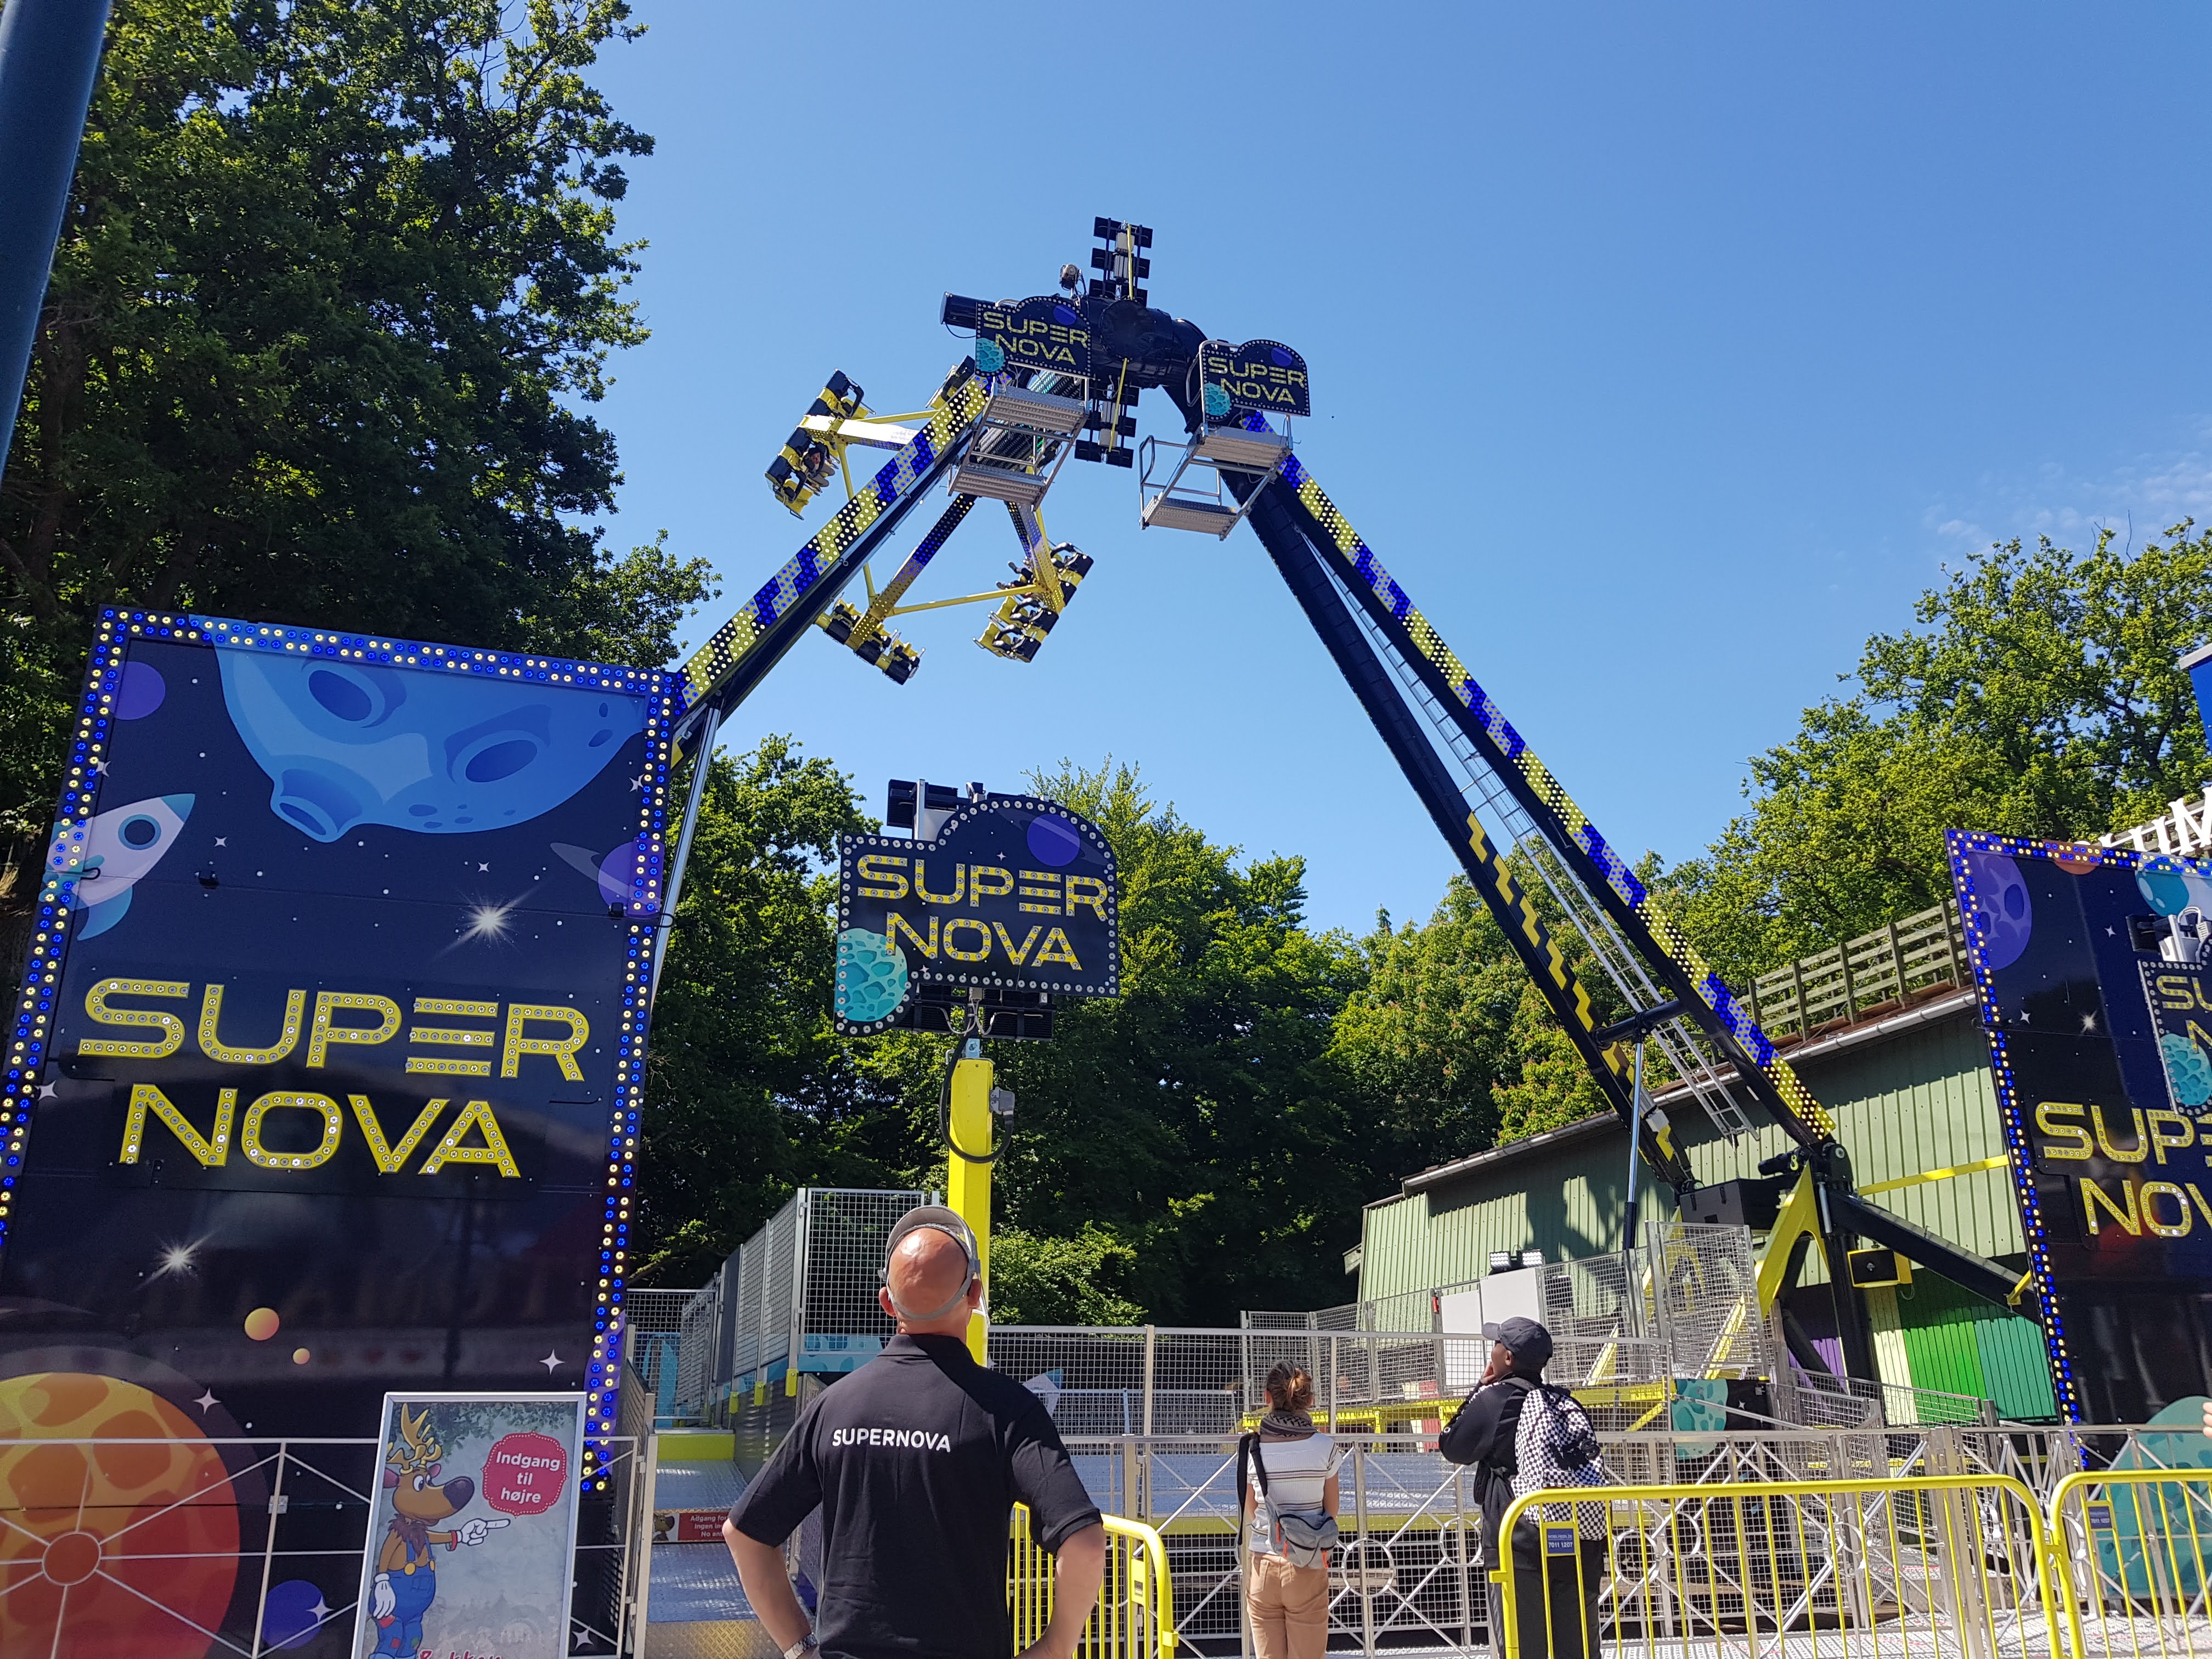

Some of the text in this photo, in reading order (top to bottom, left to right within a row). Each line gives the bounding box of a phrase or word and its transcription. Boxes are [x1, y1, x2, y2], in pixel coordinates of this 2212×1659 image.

[983, 311, 1088, 349] SUPER
[995, 333, 1077, 366] NOVA
[1207, 357, 1305, 388] SUPER
[1220, 377, 1296, 406] NOVA
[856, 853, 1109, 920] SUPER
[885, 911, 1083, 971] NOVA
[77, 977, 591, 1082] SUPER
[119, 1083, 522, 1178] NOVA
[832, 1428, 951, 1453] SUPERNOVA
[496, 1451, 561, 1471] Indgang
[517, 1472, 533, 1486] til
[500, 1487, 541, 1504] højre
